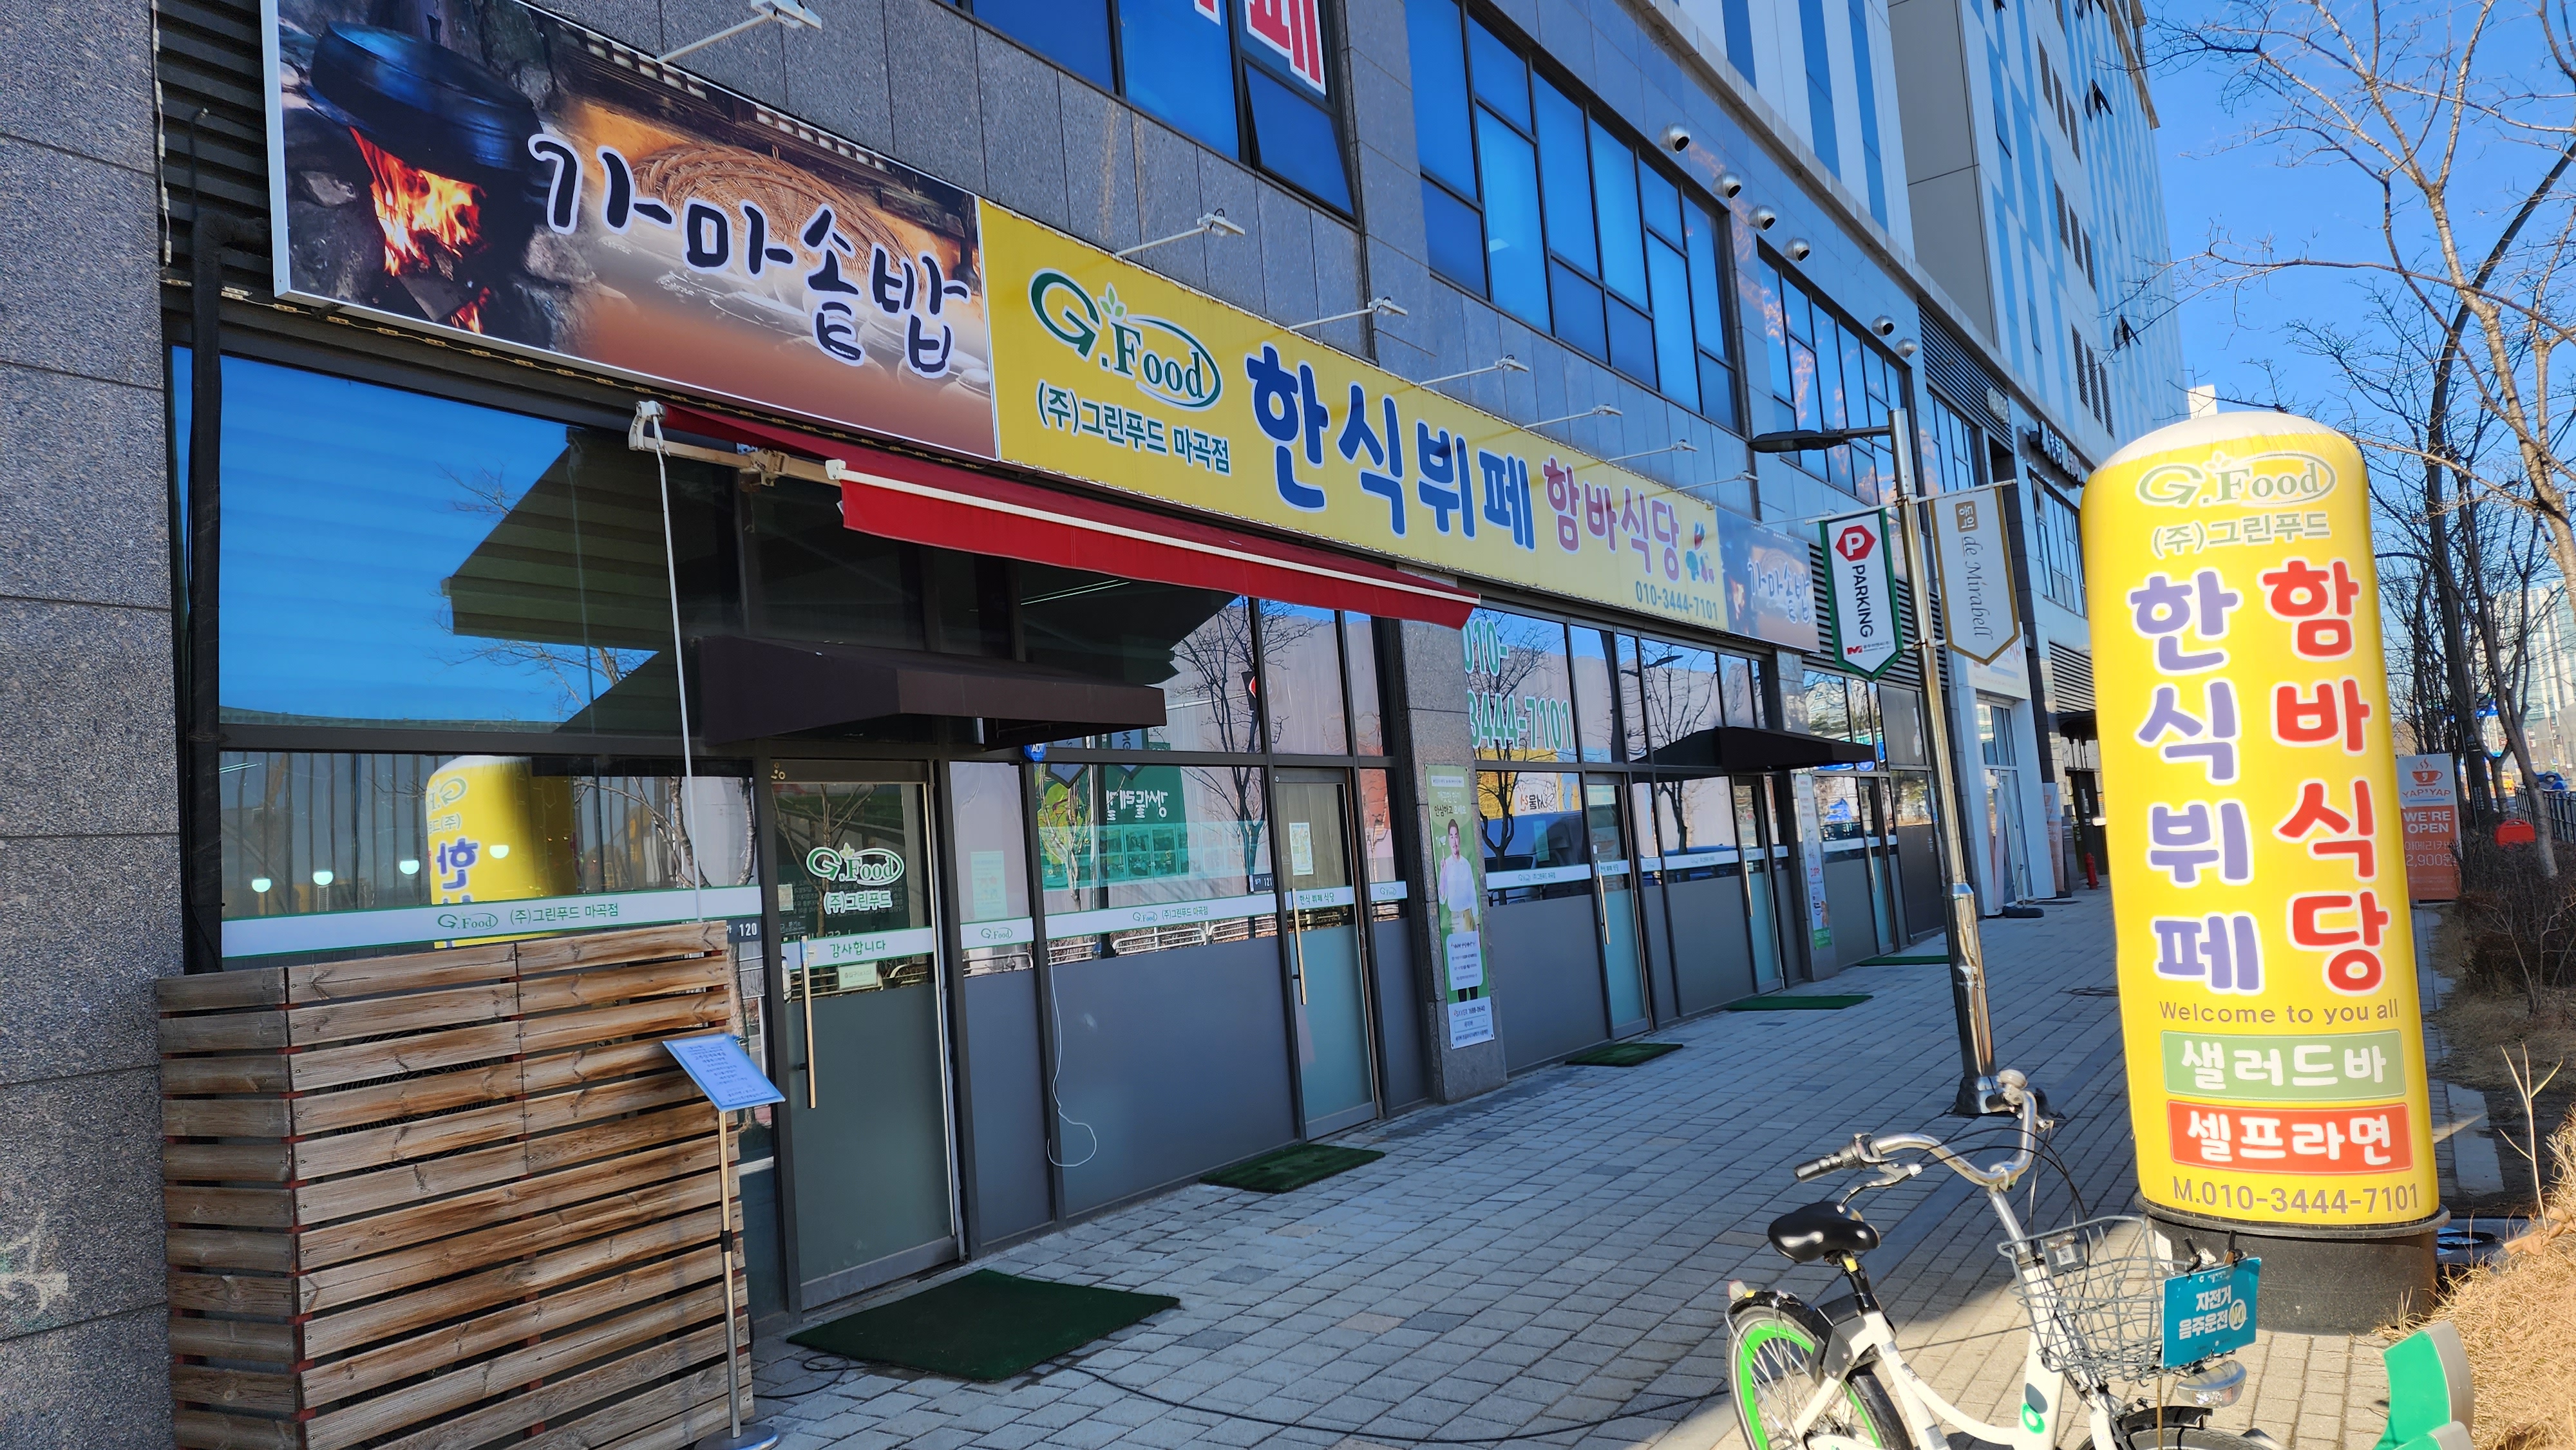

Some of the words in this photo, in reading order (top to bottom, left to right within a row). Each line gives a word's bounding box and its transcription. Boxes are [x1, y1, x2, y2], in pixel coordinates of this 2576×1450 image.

[528, 133, 971, 379] 가마솥밥
[1029, 268, 1217, 407] G.Food
[1036, 379, 1167, 457] (주)그린푸드
[1173, 426, 1231, 477] 마곡점
[2137, 453, 2334, 507] G.Food
[1542, 455, 1681, 581] 함바식당
[1963, 536, 1984, 556] de
[2152, 511, 2331, 558] (주)그린푸드
[1636, 581, 1718, 621] 010-3444-7101
[1747, 558, 1810, 625] 가마솥밥
[1852, 565, 1874, 638] PARKING
[1468, 689, 1573, 751] 3444-7101
[1434, 805, 1453, 816] 안심하고
[2403, 811, 2452, 822] WE'RE
[2408, 823, 2449, 834] OPEN
[806, 847, 904, 885] G.Food
[1264, 877, 1273, 887] 121
[824, 890, 893, 914] (주)그린푸드
[1162, 908, 1191, 919] (주)그린푸드
[1193, 906, 1208, 916] 마곡점
[1300, 894, 1310, 905] 한식
[1312, 894, 1322, 903] 뷔페
[1324, 892, 1334, 903] 식당
[437, 912, 497, 930] G.Food
[510, 907, 580, 925] (주)그린푸드
[585, 903, 618, 918] 마곡점
[739, 923, 757, 937] 120
[829, 940, 886, 958] 감사합니다
[2159, 1001, 2275, 1024] Welcome
[2287, 1004, 2313, 1024] to
[2323, 1005, 2370, 1026] you
[2376, 999, 2400, 1021] all
[2181, 1039, 2387, 1091] 샐러드바
[2187, 1111, 2392, 1166] 셀프라면
[2172, 1176, 2420, 1214] M.010-3444-7101
[2196, 1285, 2231, 1312] 자전거
[2179, 1310, 2228, 1340] 음주운전
